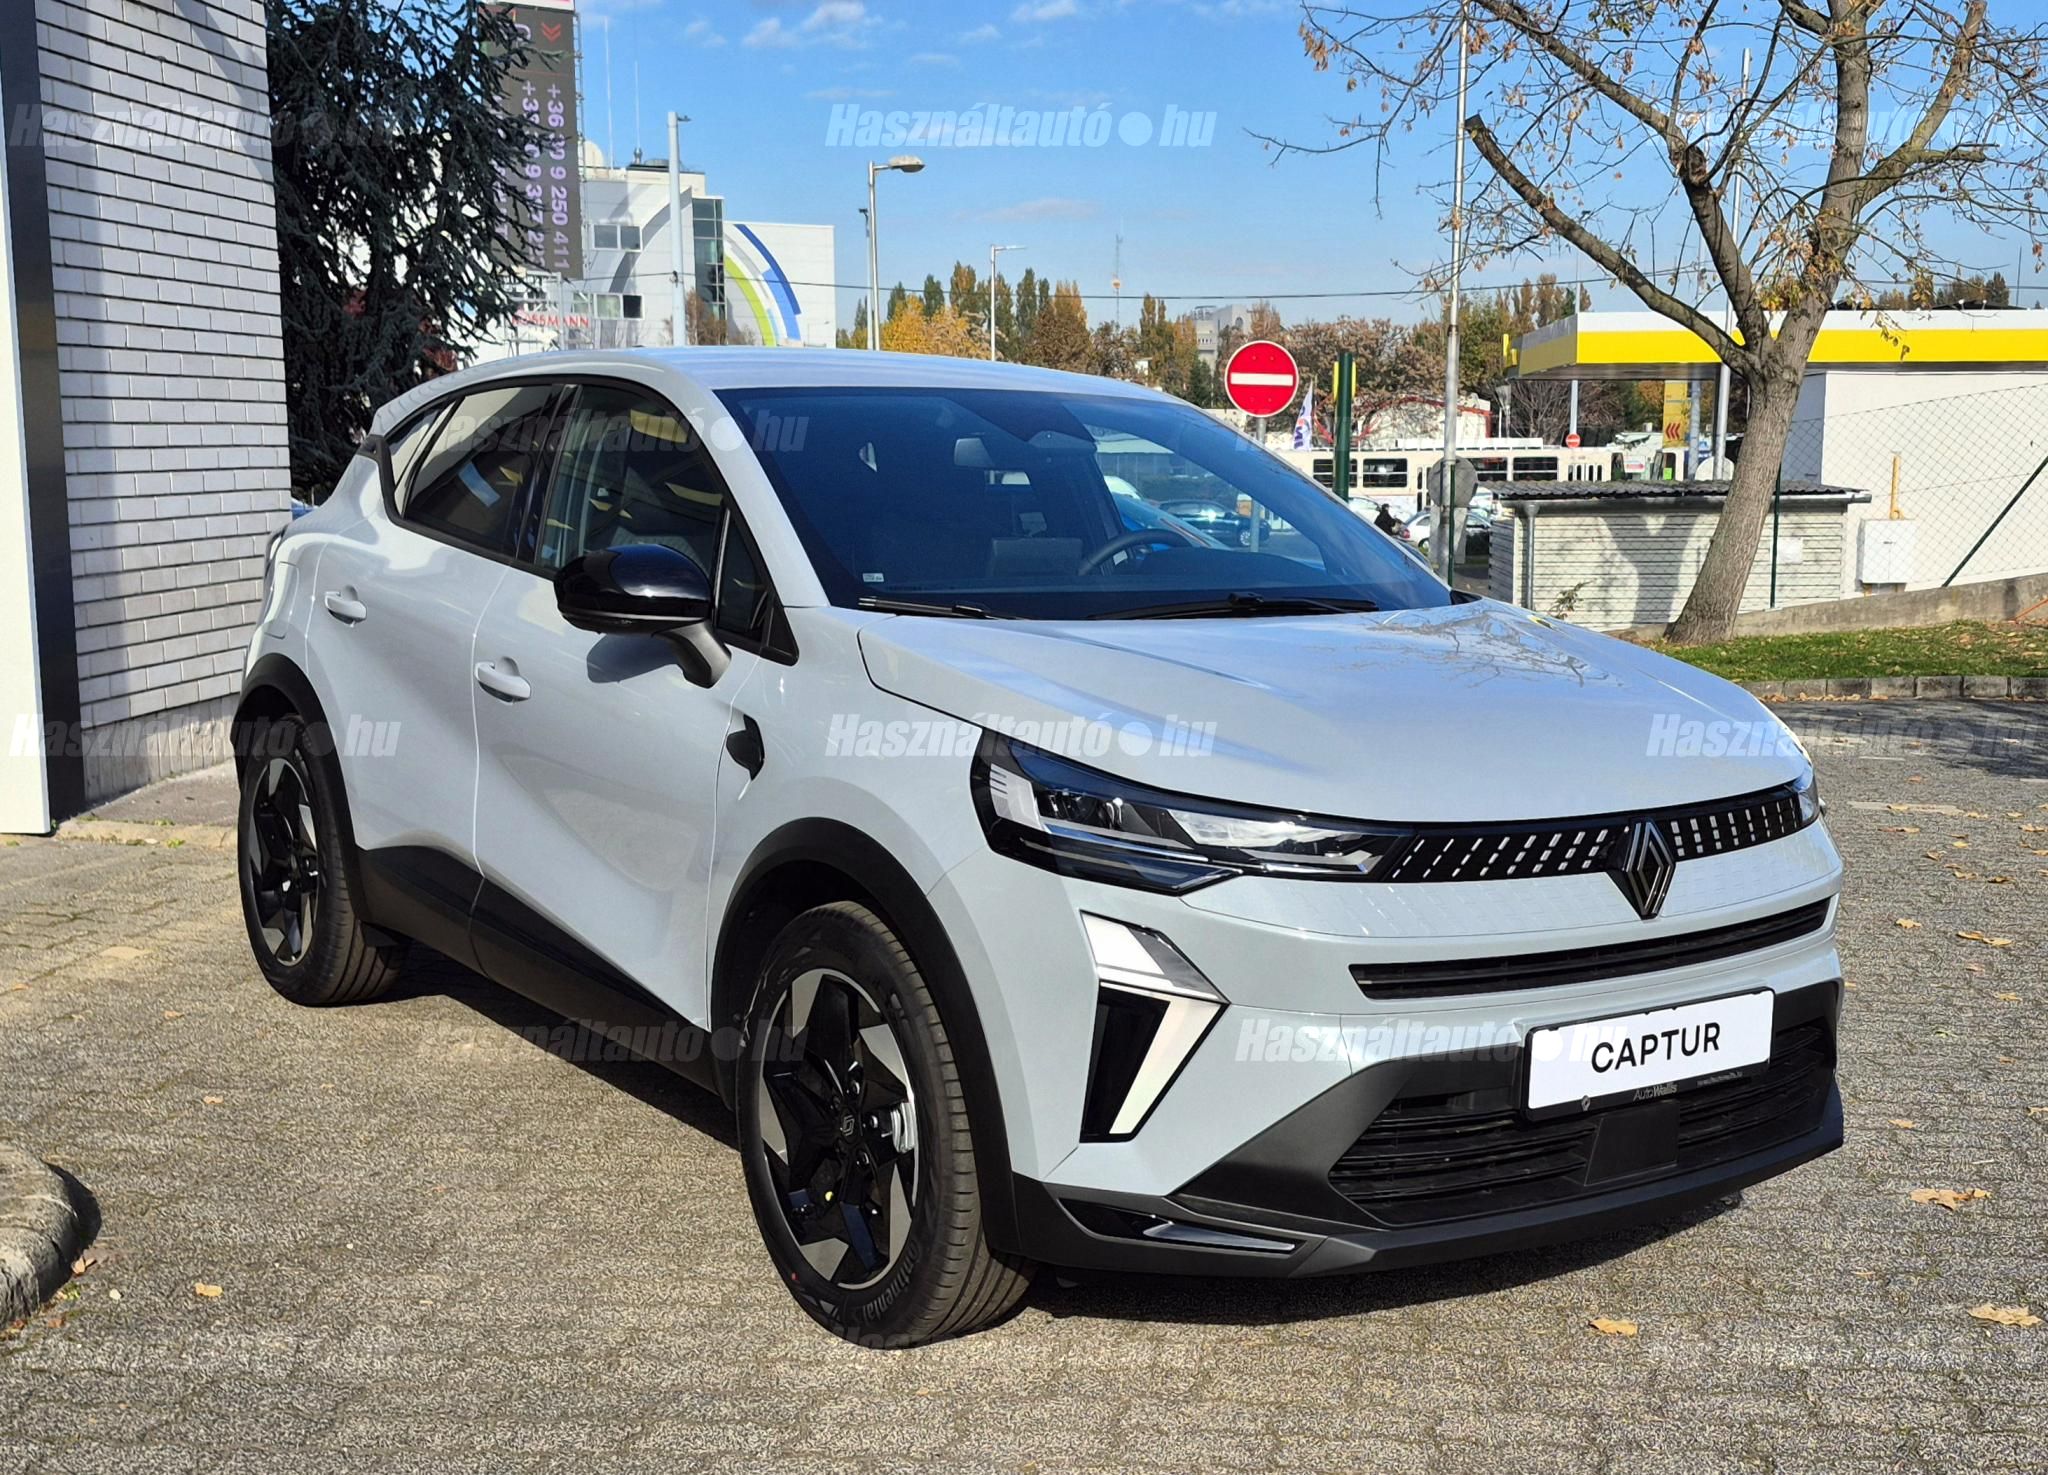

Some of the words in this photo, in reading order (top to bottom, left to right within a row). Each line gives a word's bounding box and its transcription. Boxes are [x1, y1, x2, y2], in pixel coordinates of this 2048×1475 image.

[550, 166, 567, 180] 9
[551, 185, 569, 226] 250
[553, 231, 571, 269] 411
[1591, 1022, 1720, 1073] CAPTUR
